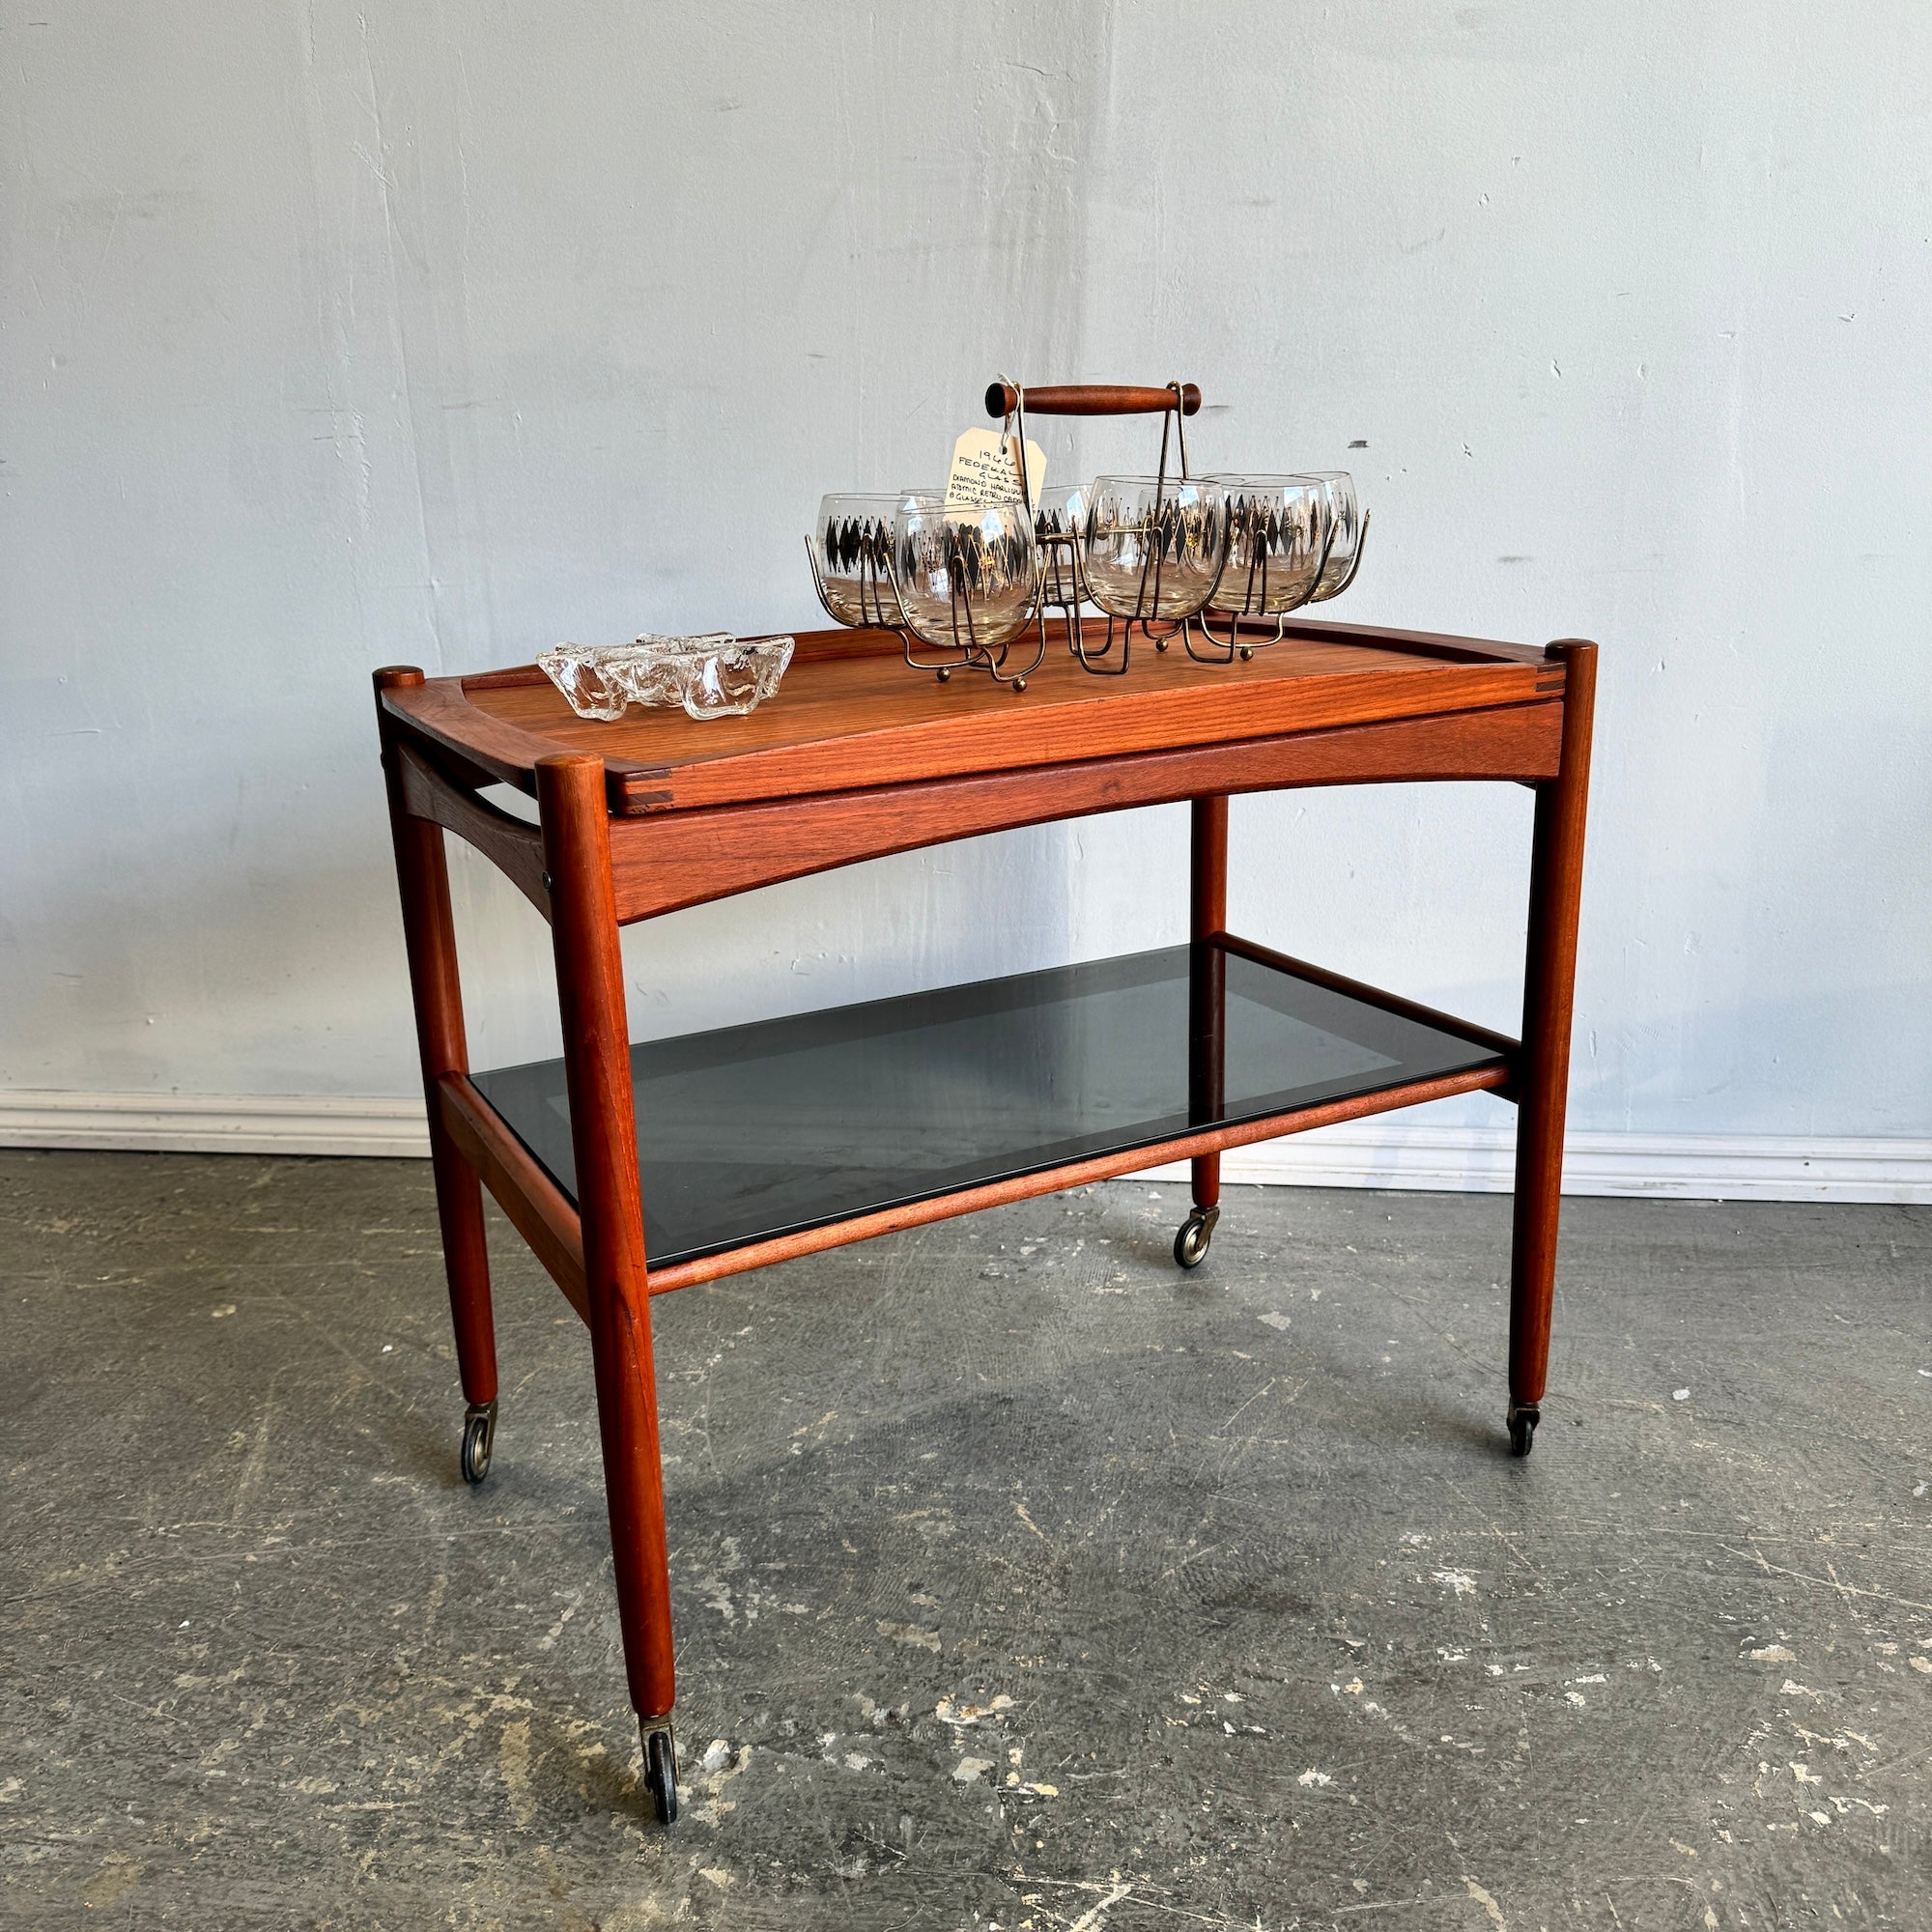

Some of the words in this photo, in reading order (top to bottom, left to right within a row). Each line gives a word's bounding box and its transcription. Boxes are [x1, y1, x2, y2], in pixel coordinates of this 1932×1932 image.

[959, 456, 1024, 476] FEDERAL
[980, 450, 1015, 466] 1966
[952, 474, 986, 488] DIAMOND
[979, 471, 1022, 486] GLASS
[951, 483, 977, 495] ATOMIC
[980, 489, 1002, 500] RETRO
